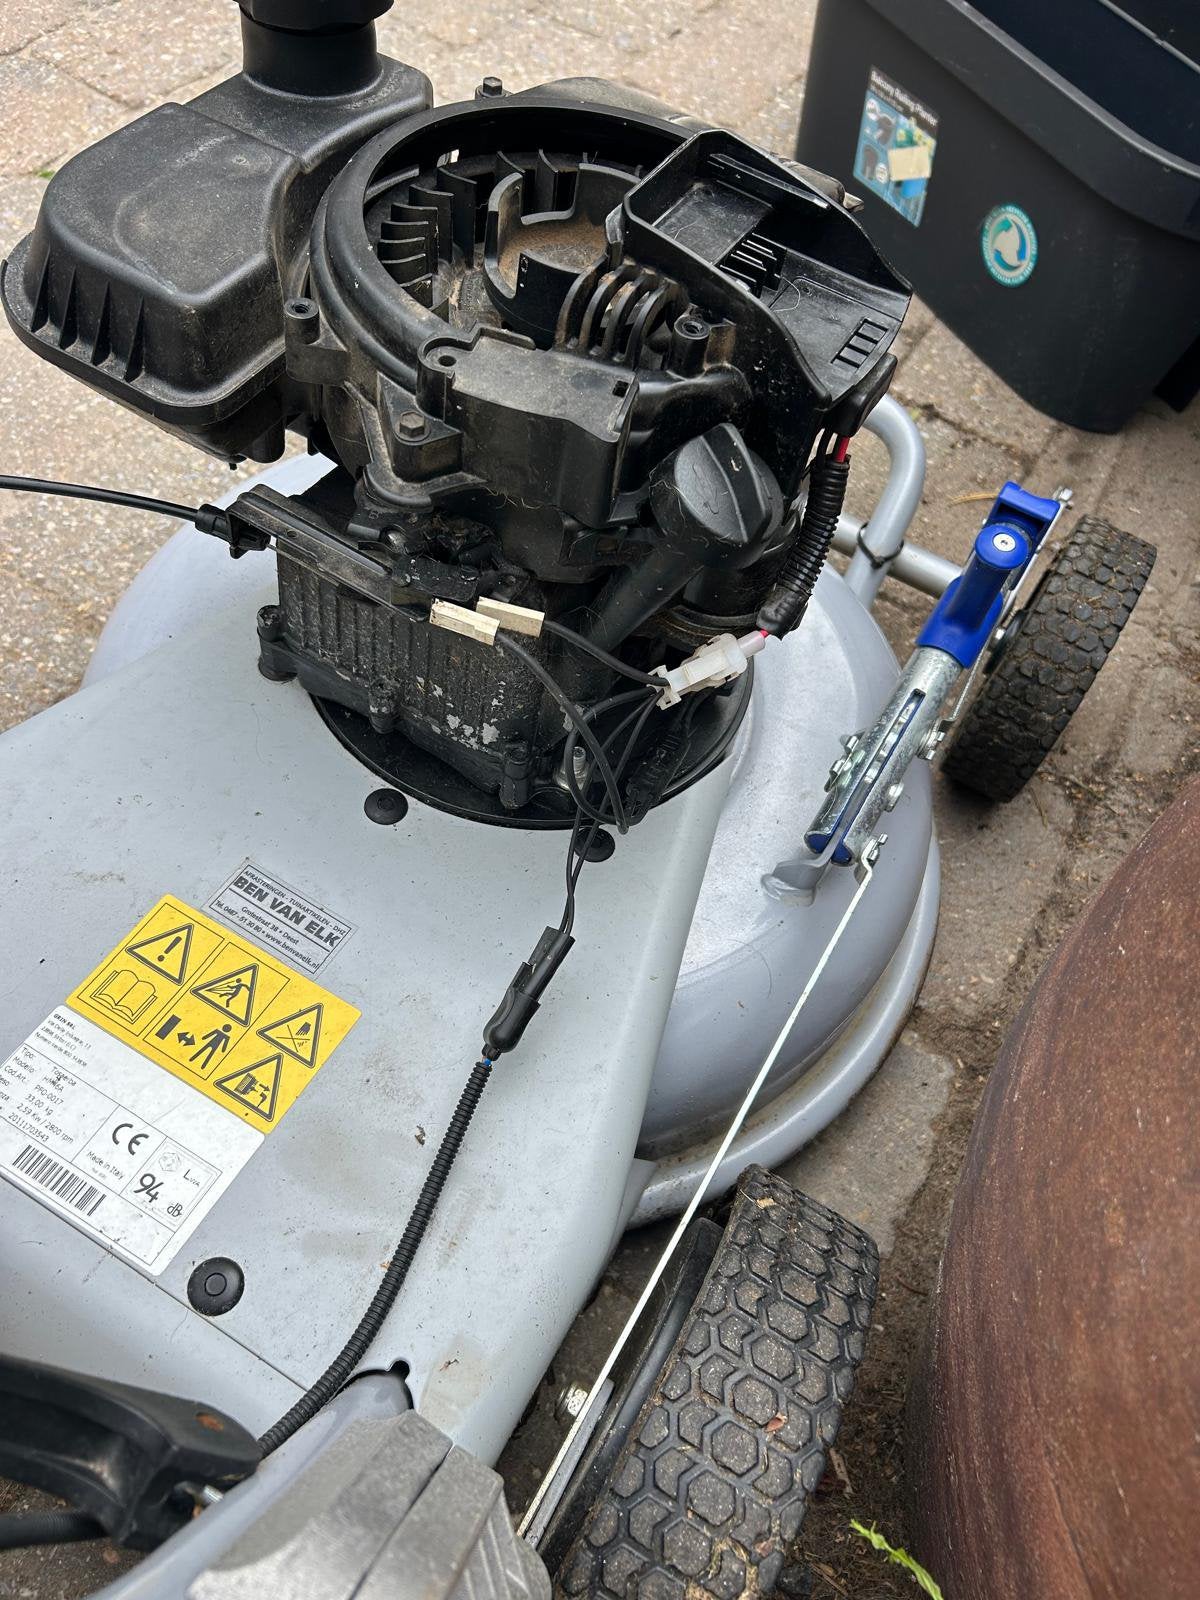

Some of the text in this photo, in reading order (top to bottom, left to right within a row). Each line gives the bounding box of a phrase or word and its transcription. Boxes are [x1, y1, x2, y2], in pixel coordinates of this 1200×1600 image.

[233, 876, 340, 947] BEN VAN ELK
[244, 870, 286, 898] AFRASTERINGEN
[289, 898, 329, 927] TUINARTIKELEN
[332, 925, 347, 936] DHZ
[223, 905, 238, 917] 0487
[265, 933, 320, 969] www.benvanelk.nl
[241, 906, 300, 945] Grotestraat 38 Deest
[53, 1013, 67, 1023] GRIN
[44, 1121, 63, 1136] 2800
[87, 1151, 104, 1166] Made
[110, 1165, 125, 1180] Italy
[133, 1173, 164, 1203] 94
[166, 1202, 184, 1218] dB
